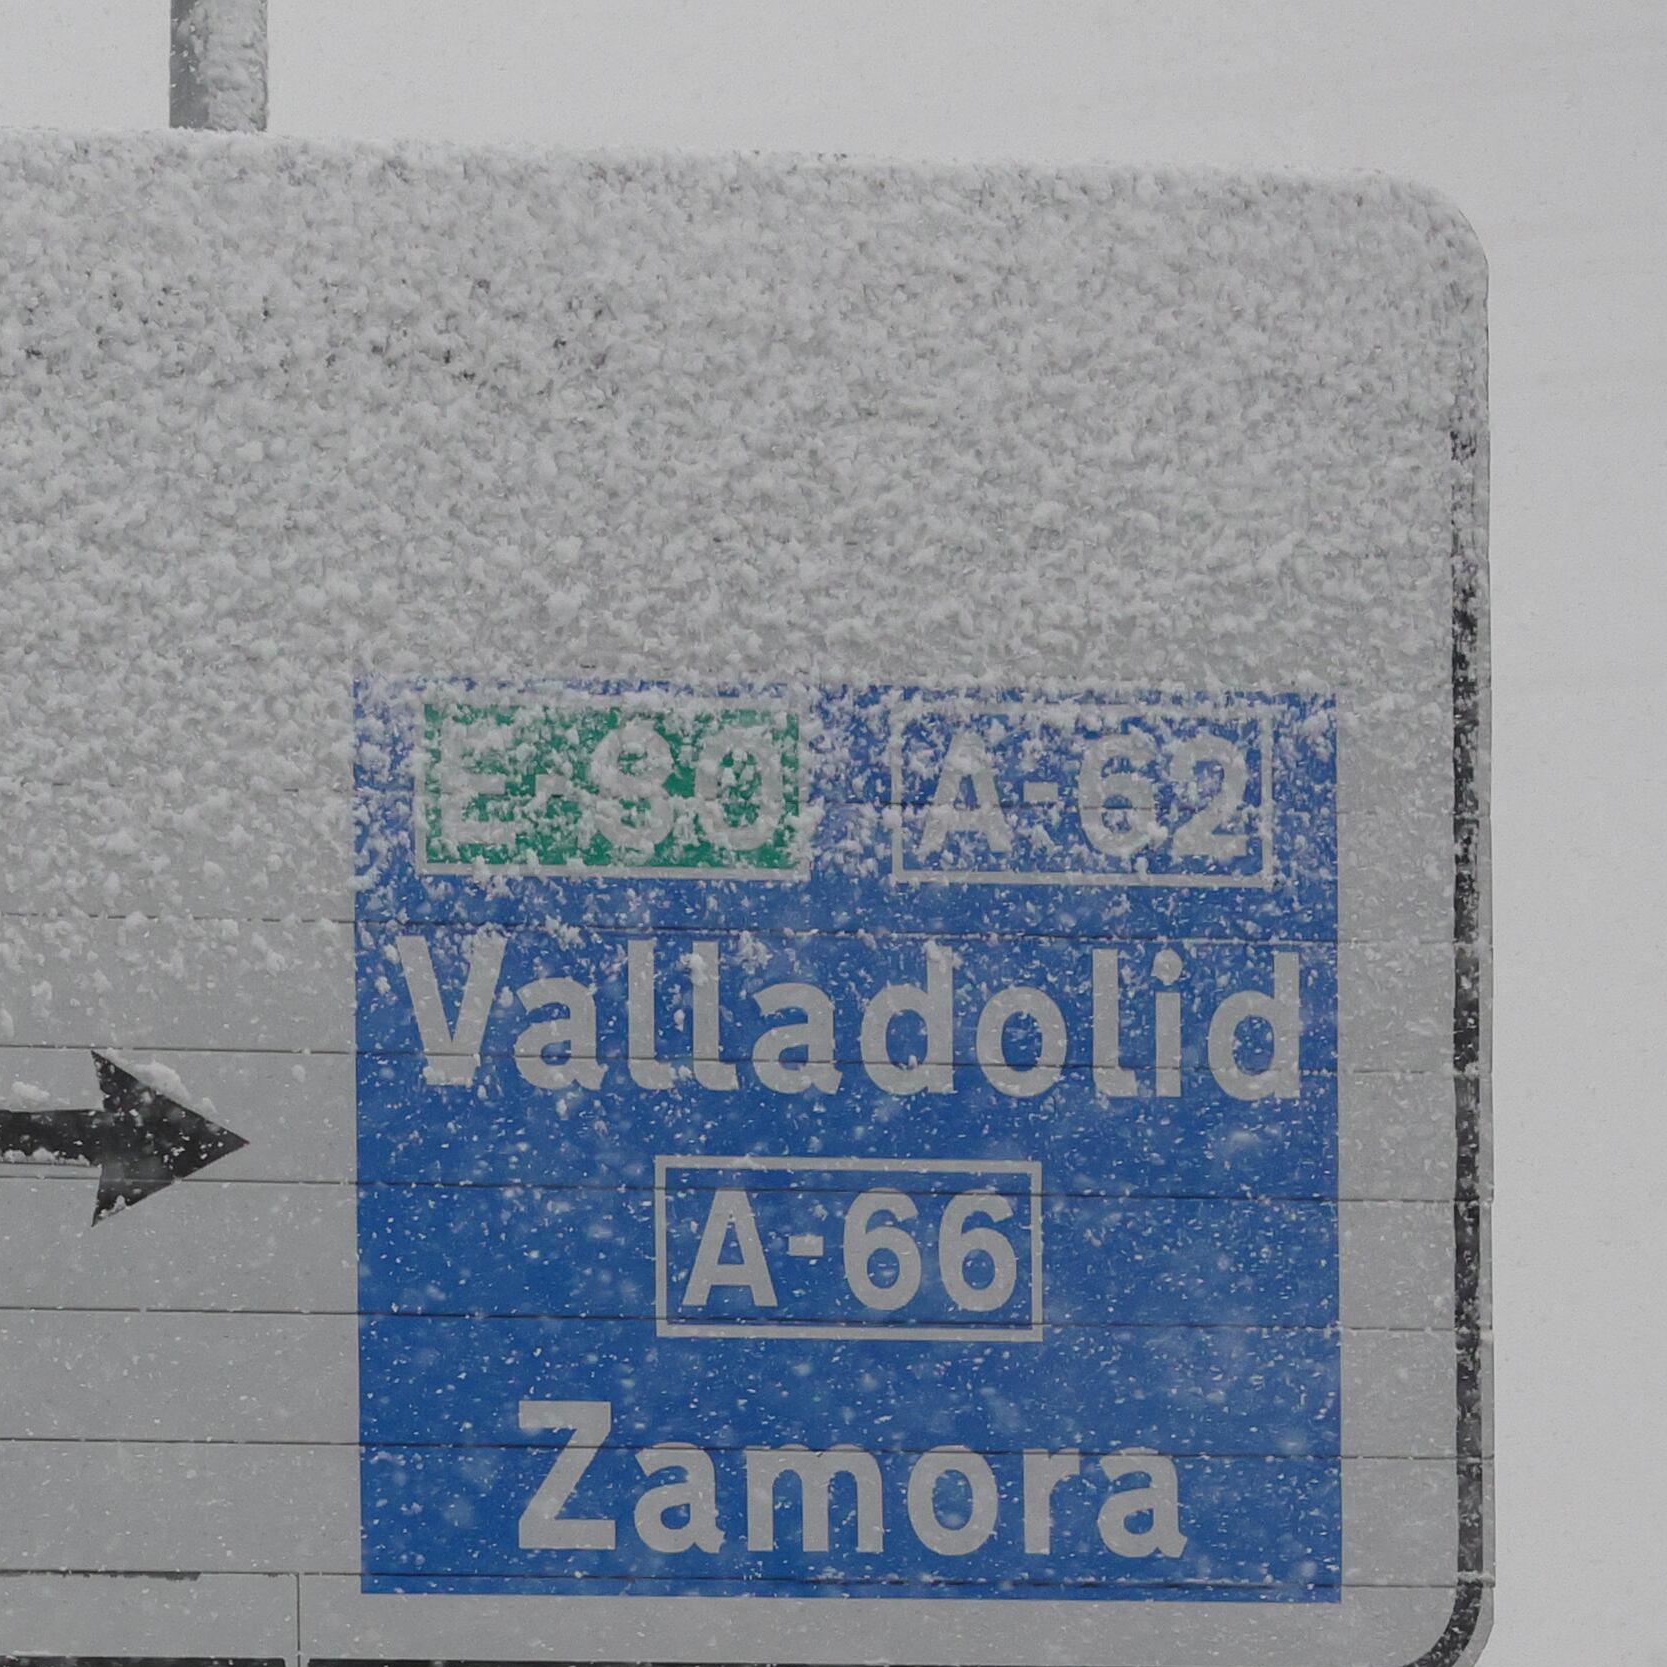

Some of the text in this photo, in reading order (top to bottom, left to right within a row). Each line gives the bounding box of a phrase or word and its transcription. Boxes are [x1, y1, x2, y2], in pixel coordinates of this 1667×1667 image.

[918, 731, 1249, 858] A-62
[395, 934, 1301, 1101] Valladolid
[681, 1187, 1021, 1313] A-66
[516, 1399, 1189, 1559] Zamora
